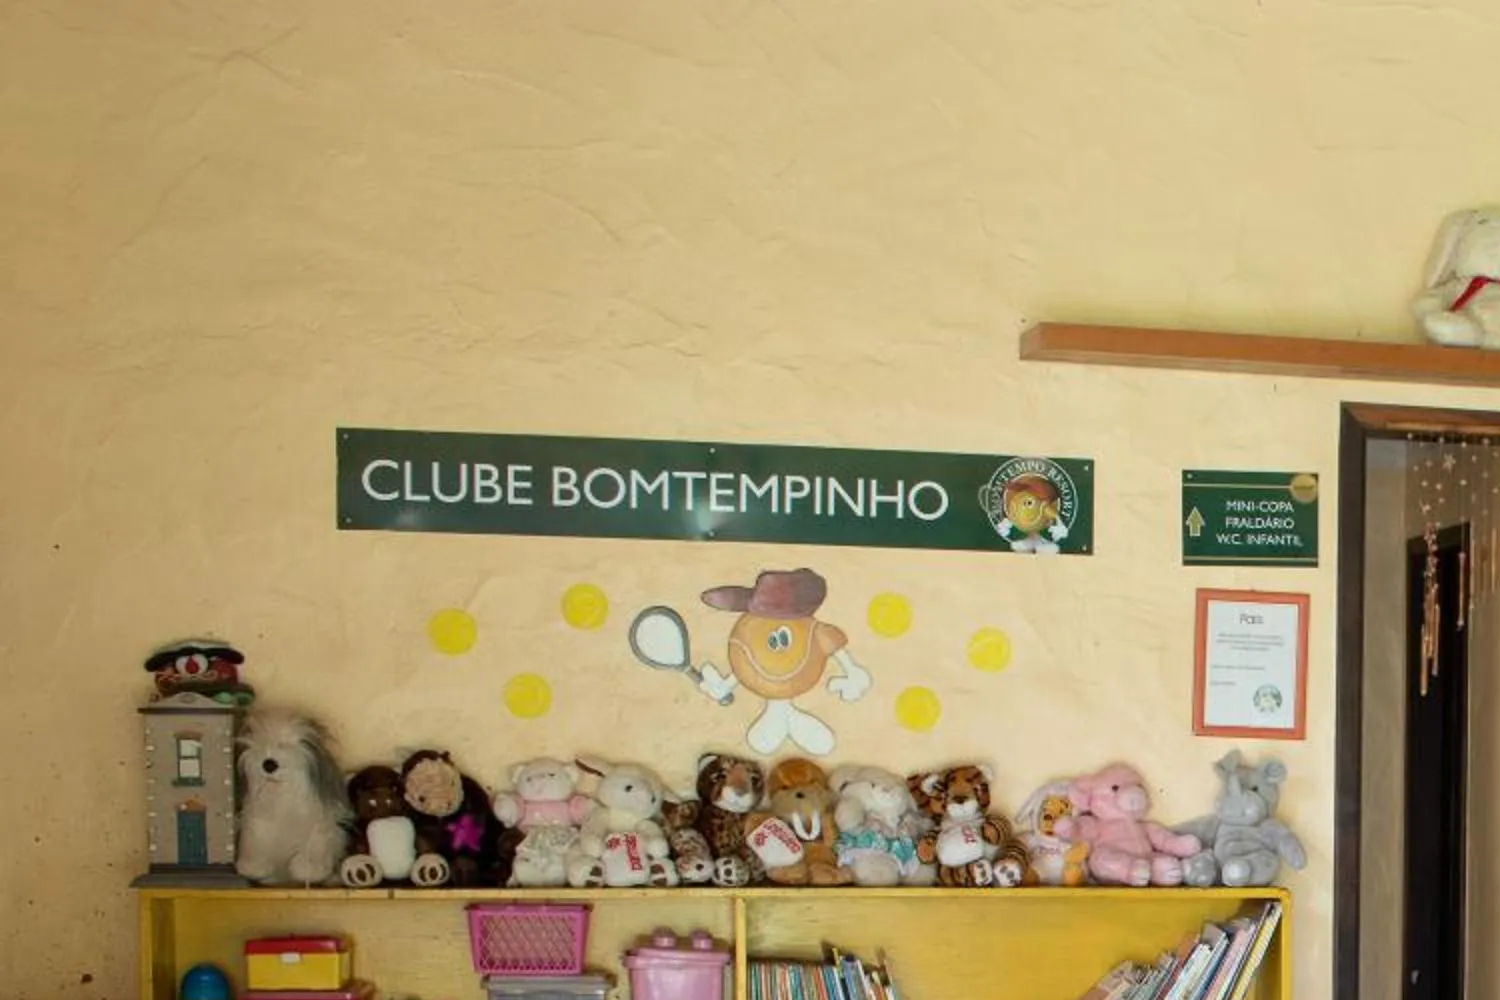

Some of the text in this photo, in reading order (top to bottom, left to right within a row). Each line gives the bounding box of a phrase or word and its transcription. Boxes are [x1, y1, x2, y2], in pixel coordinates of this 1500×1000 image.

[361, 459, 949, 521] CLUBE BOMTEMPINHO
[1225, 500, 1295, 513] MINI-COPA
[1246, 533, 1304, 547] INFANTIL
